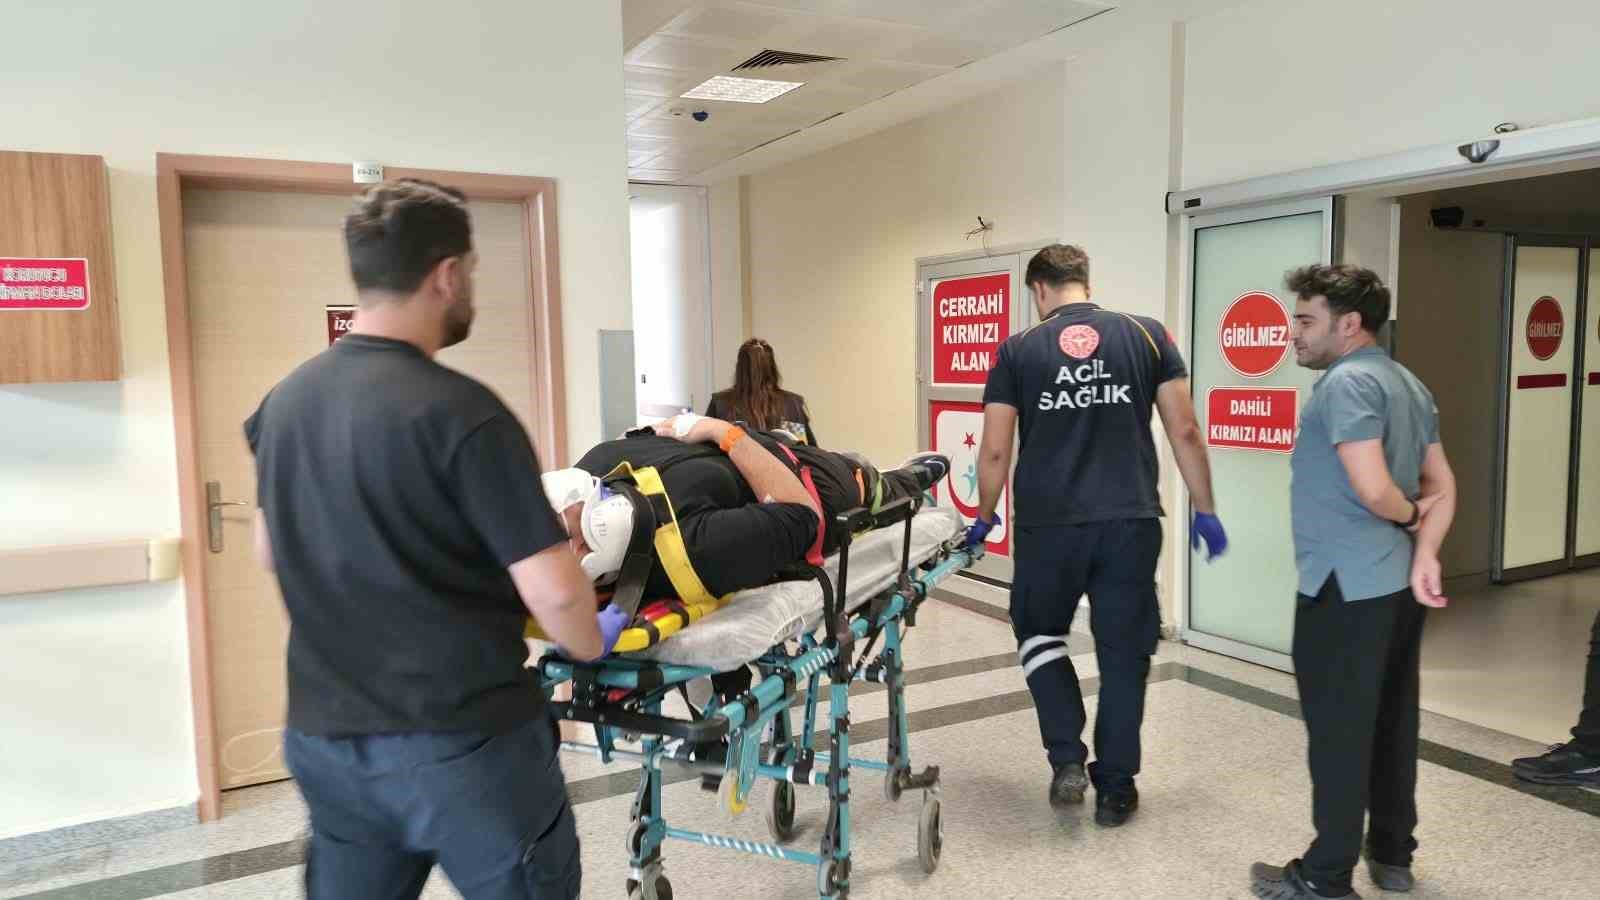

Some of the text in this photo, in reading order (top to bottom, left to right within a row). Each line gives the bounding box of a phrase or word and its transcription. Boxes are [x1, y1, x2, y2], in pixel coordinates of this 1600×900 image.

[940, 288, 1004, 318] CERRAHİ
[943, 322, 999, 344] KIRMIZI
[1223, 322, 1287, 347] GİRİLMEZ
[950, 352, 990, 371] ALAN
[1038, 384, 1132, 410] SAĞLIK
[1230, 396, 1271, 416] DAHİLİ
[1210, 424, 1292, 445] KIRMIZI ALAN
